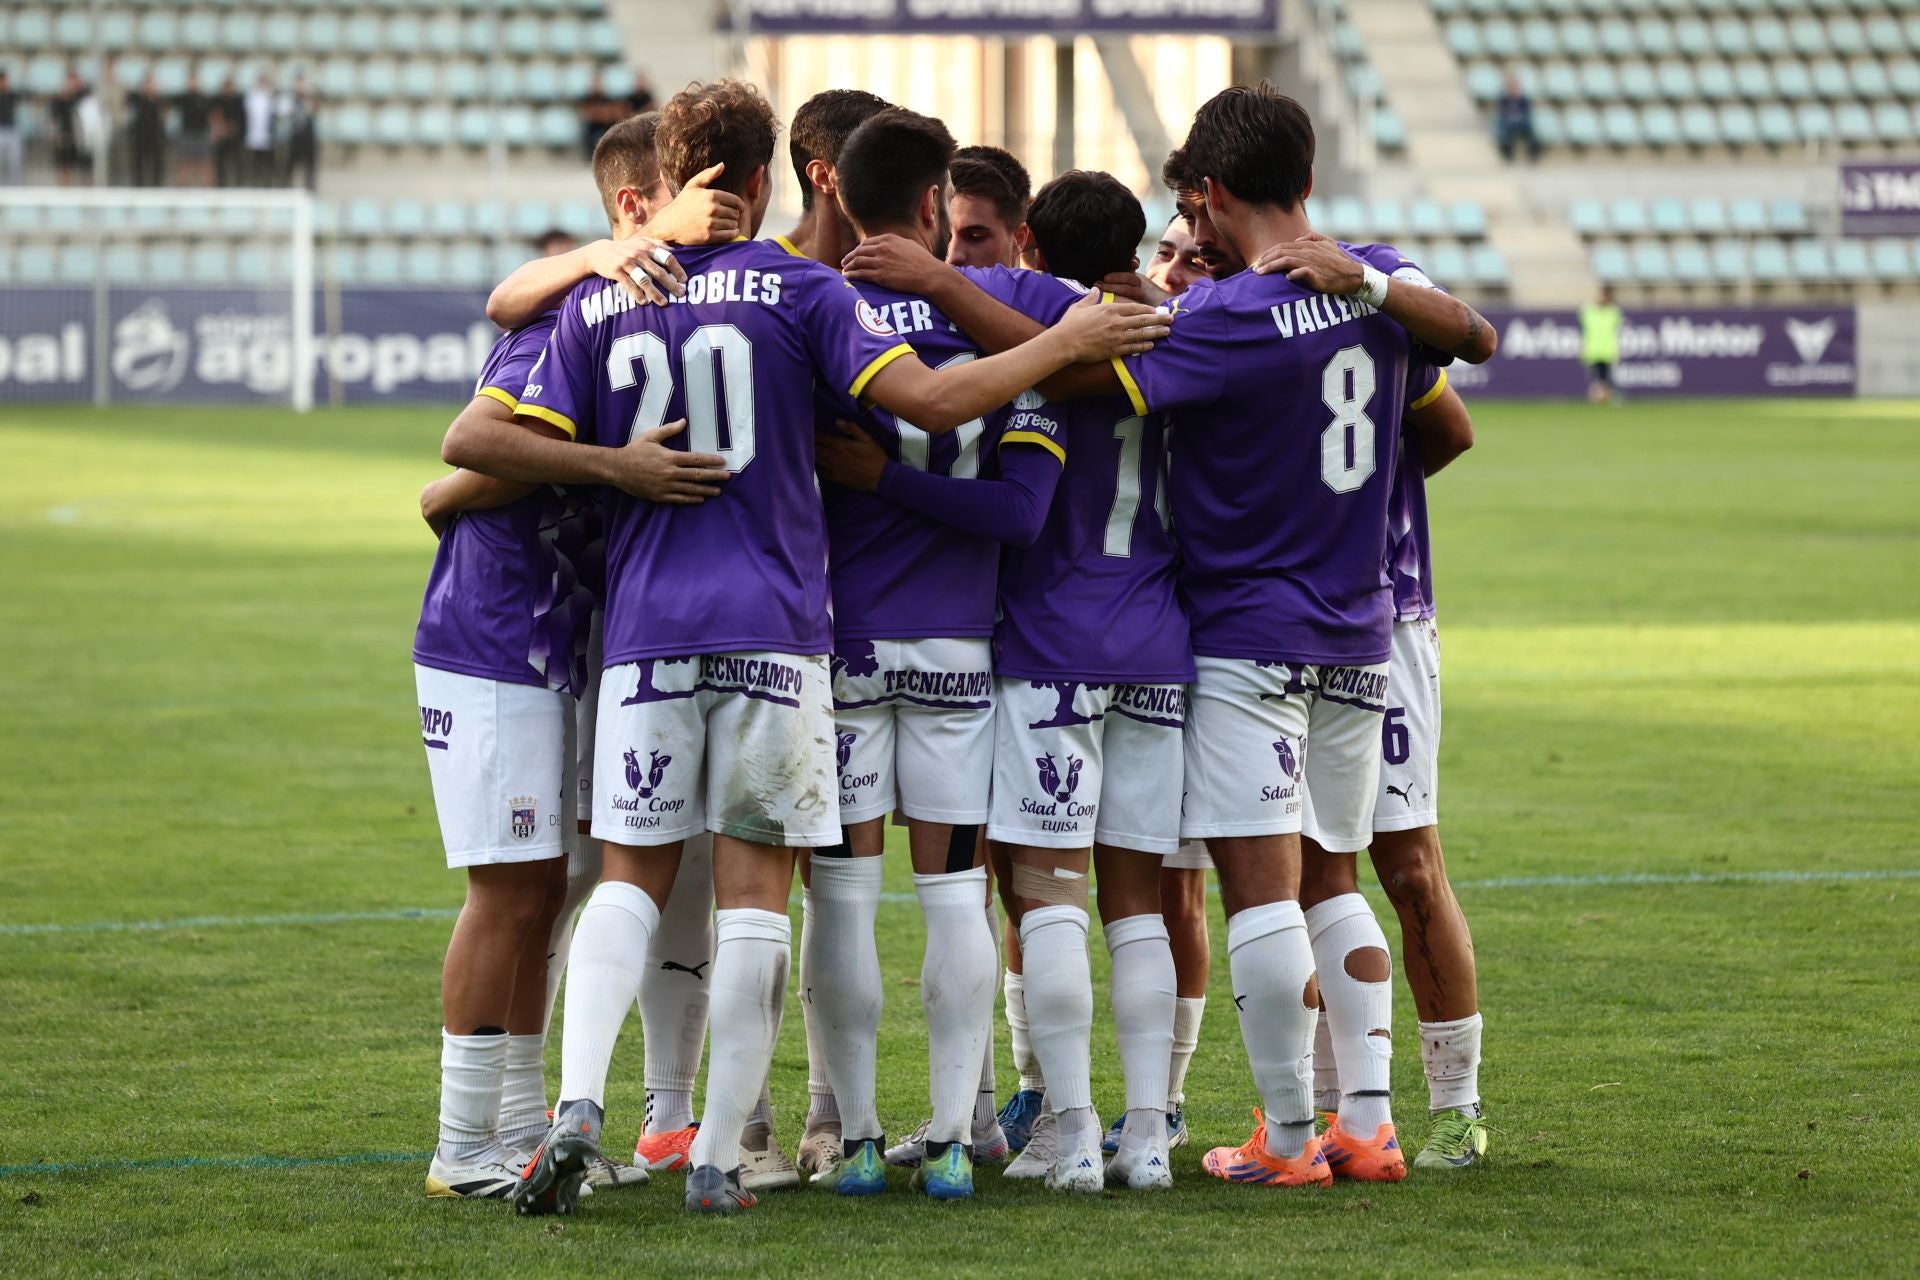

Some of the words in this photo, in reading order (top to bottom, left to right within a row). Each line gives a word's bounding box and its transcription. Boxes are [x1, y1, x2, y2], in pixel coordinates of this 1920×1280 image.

[669, 269, 782, 306] OBLES
[606, 323, 756, 474] 20
[1320, 343, 1377, 495] 8
[699, 655, 803, 696] TECNICAMPO
[883, 669, 992, 698] TECNICAMPO
[1382, 706, 1411, 766] 6
[841, 771, 879, 788] Coop
[611, 794, 640, 812] Sdad
[648, 797, 686, 814] Coop
[1260, 783, 1296, 802] Sdad
[1019, 797, 1058, 817] Sdad
[1066, 801, 1097, 819] Coop
[625, 815, 661, 830] EUJISA
[1041, 820, 1079, 834] EUJISA
